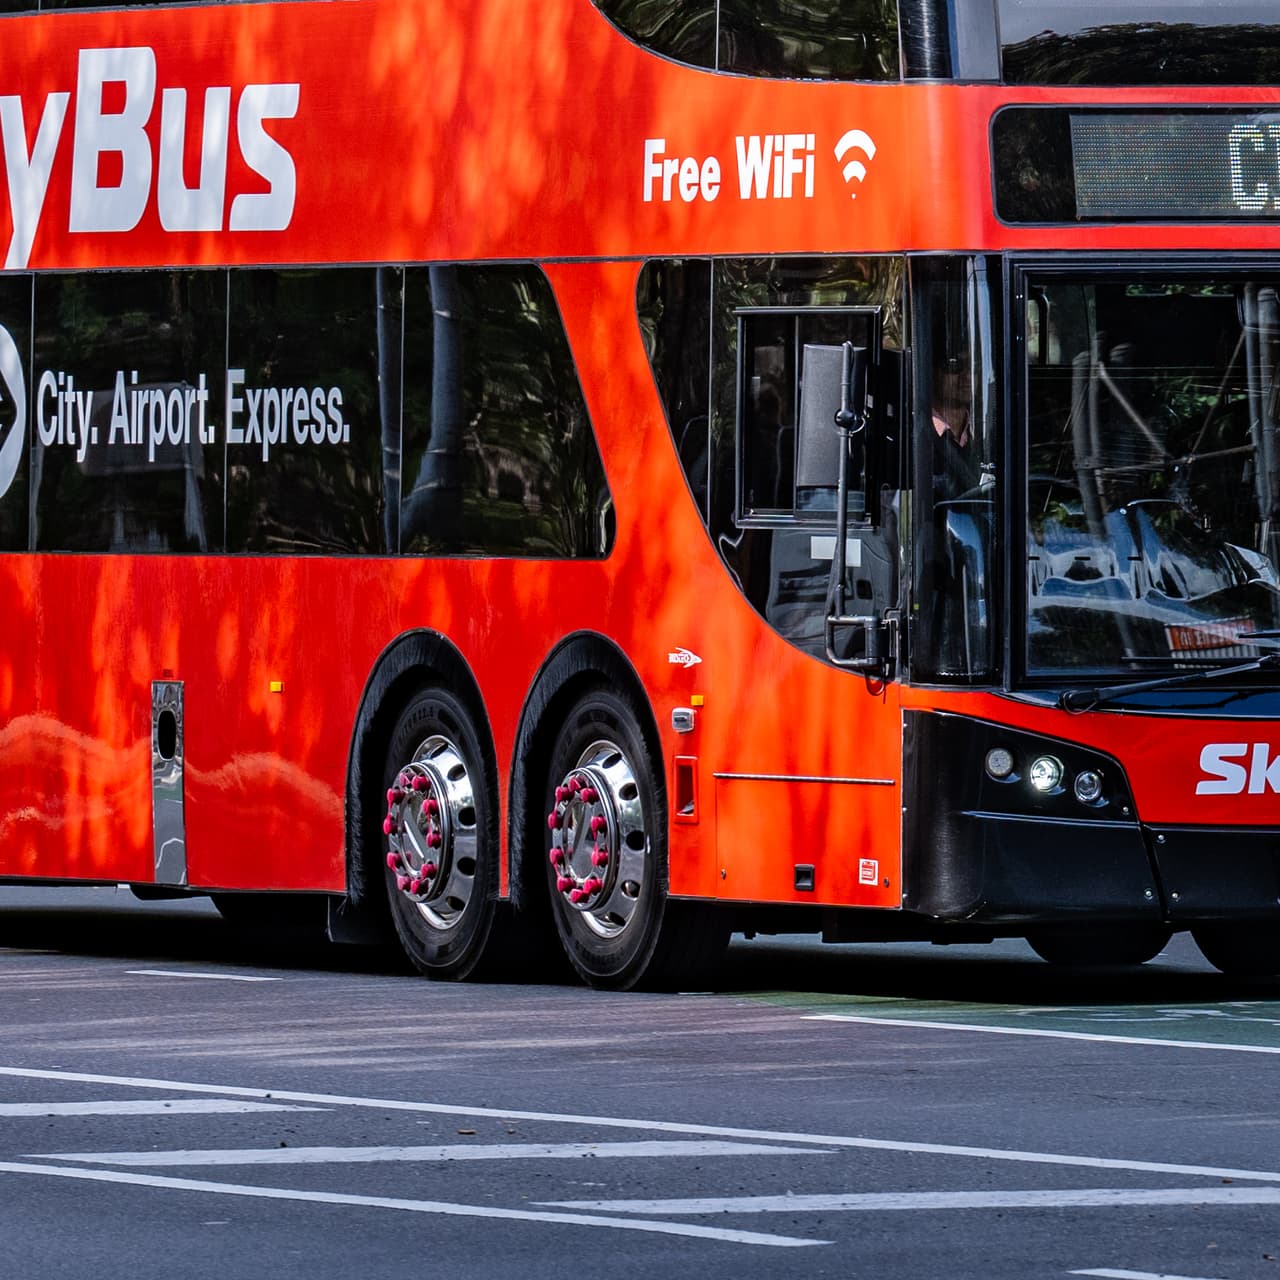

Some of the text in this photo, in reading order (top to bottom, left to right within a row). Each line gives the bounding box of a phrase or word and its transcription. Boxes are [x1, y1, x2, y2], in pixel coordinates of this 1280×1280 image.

[642, 133, 816, 203] Free WiFi
[37, 368, 351, 463] City. Airport. Express.
